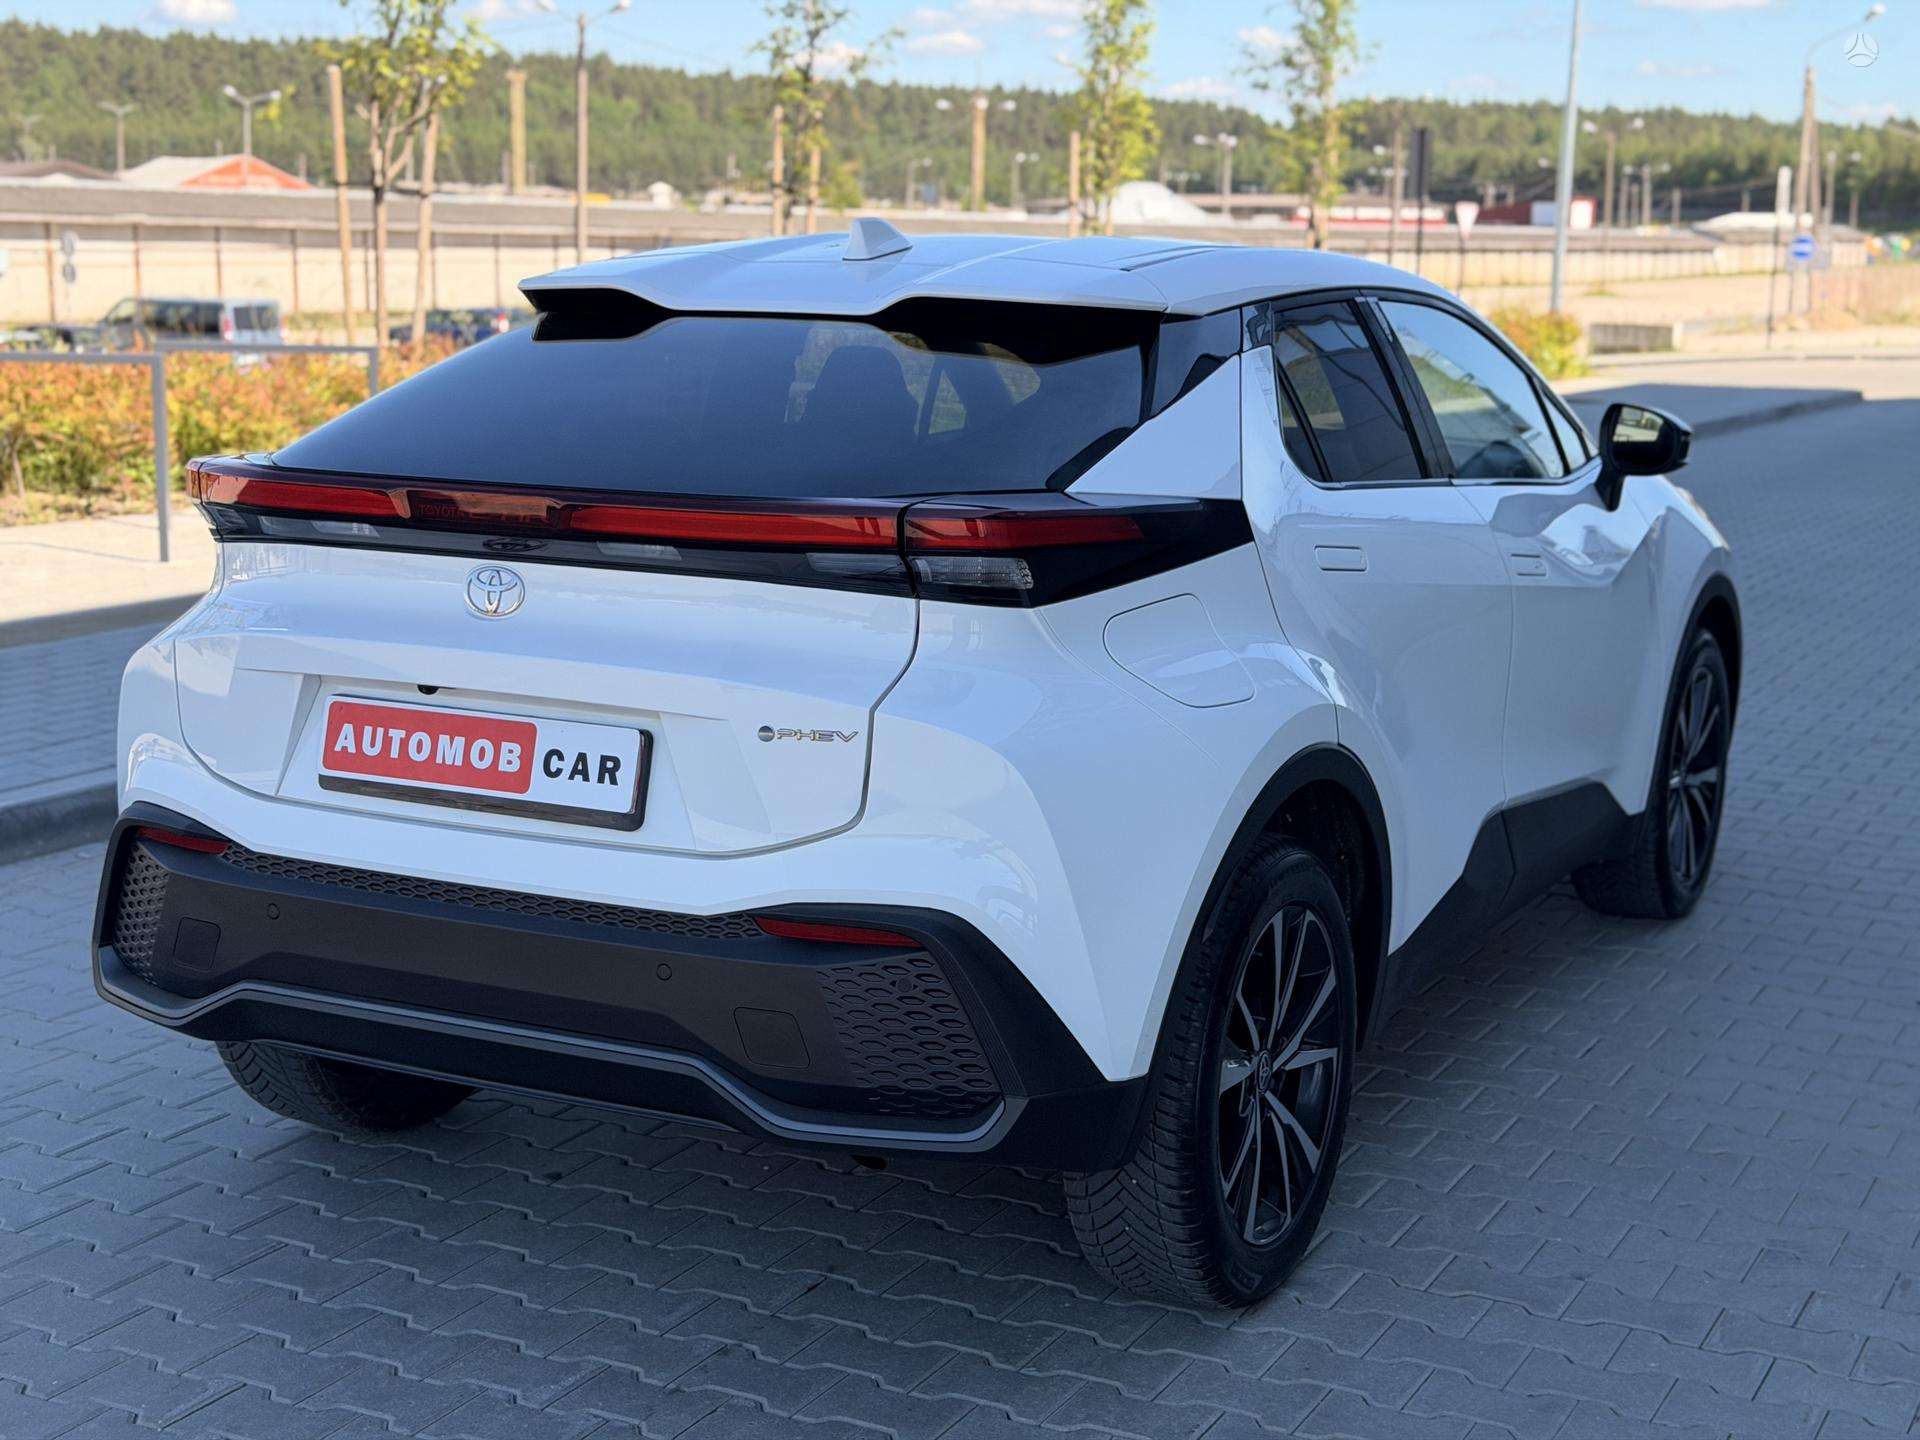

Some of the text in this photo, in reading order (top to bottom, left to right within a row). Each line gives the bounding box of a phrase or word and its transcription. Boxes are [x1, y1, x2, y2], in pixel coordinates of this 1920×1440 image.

[776, 728, 859, 742] PHEV
[334, 723, 622, 786] AUTOMOB CAR
